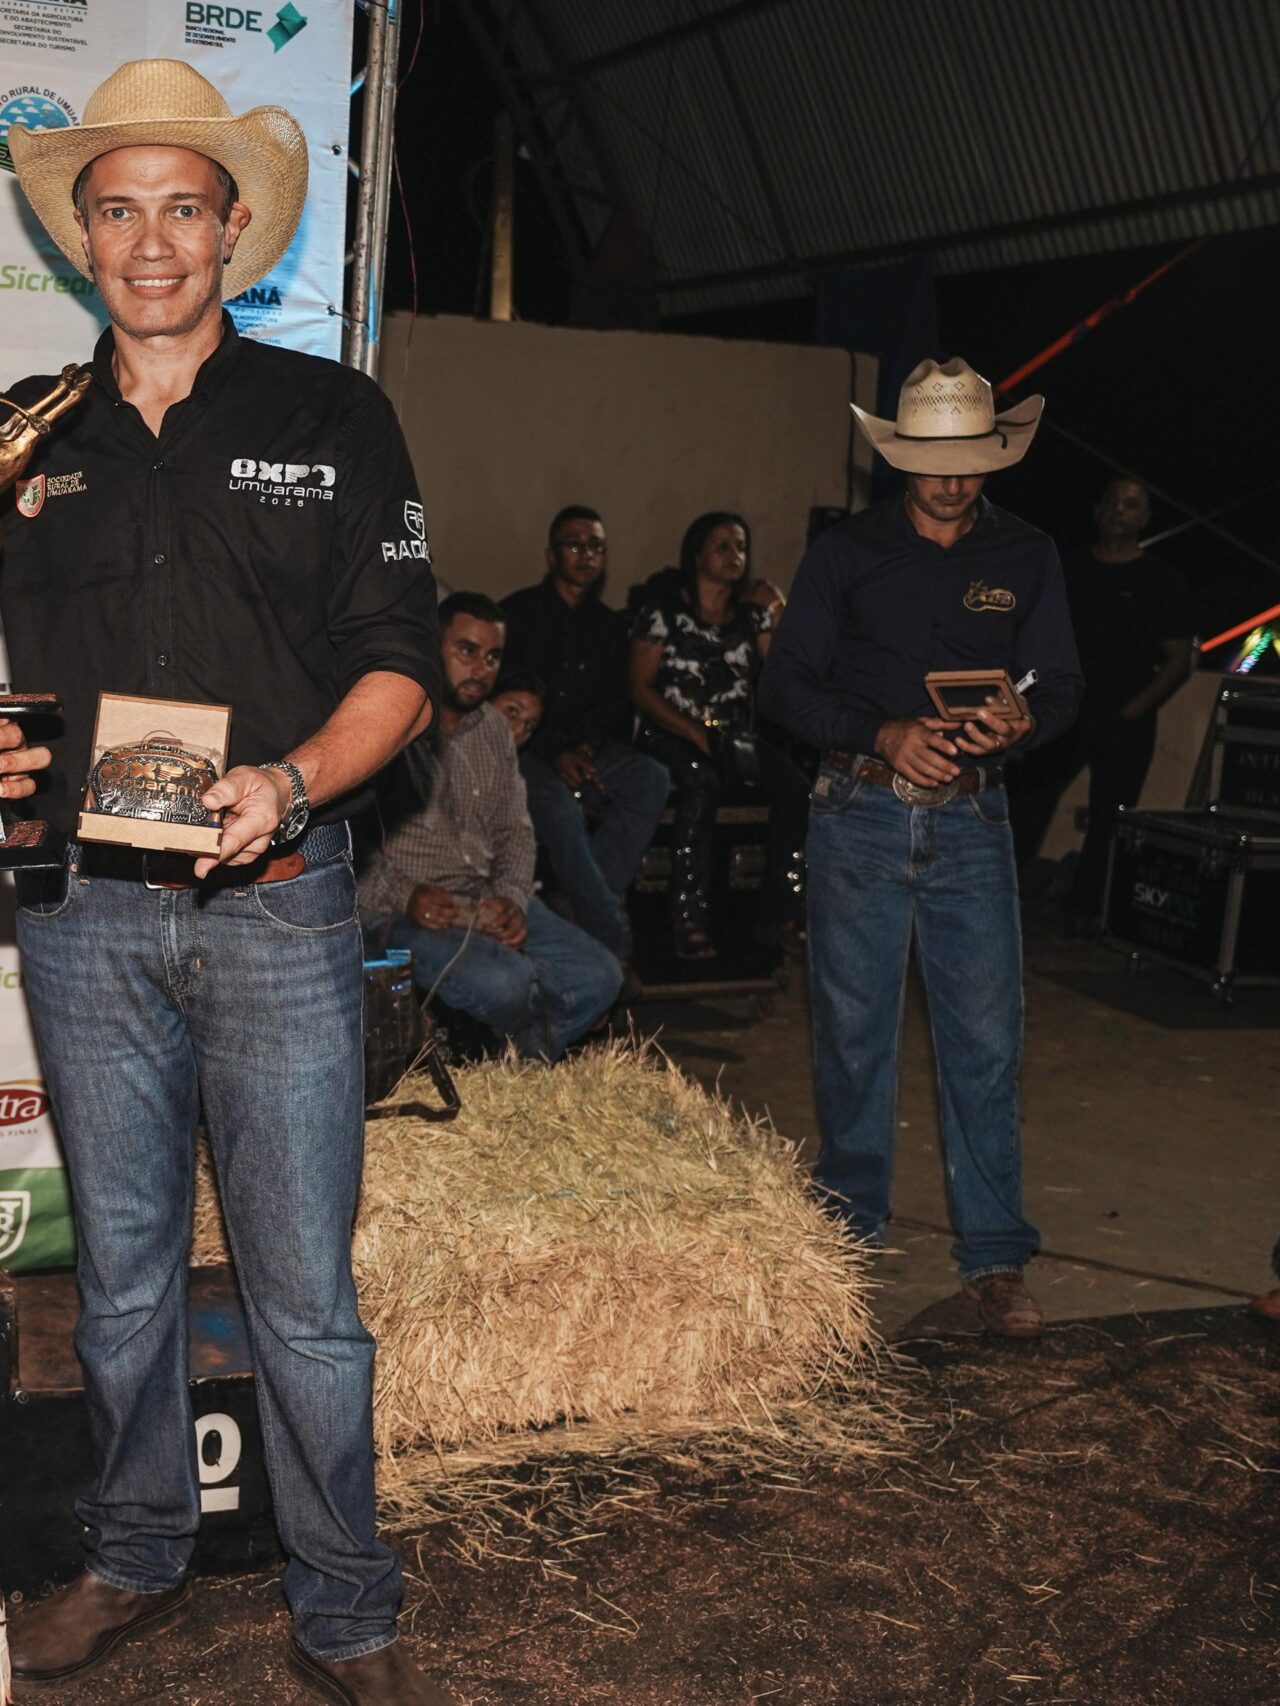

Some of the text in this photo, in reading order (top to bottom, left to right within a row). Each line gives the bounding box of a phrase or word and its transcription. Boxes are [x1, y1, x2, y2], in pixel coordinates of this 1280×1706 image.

[21, 17, 72, 28] ABASTECIMENTO
[42, 12, 84, 23] AGRICULTURA
[185, 1, 263, 33] BRDE
[13, 24, 51, 34] SECRETARIA
[49, 44, 76, 52] TURISMO
[9, 86, 41, 98] RURAL
[42, 88, 57, 100] DE
[259, 496, 304, 507] 2026
